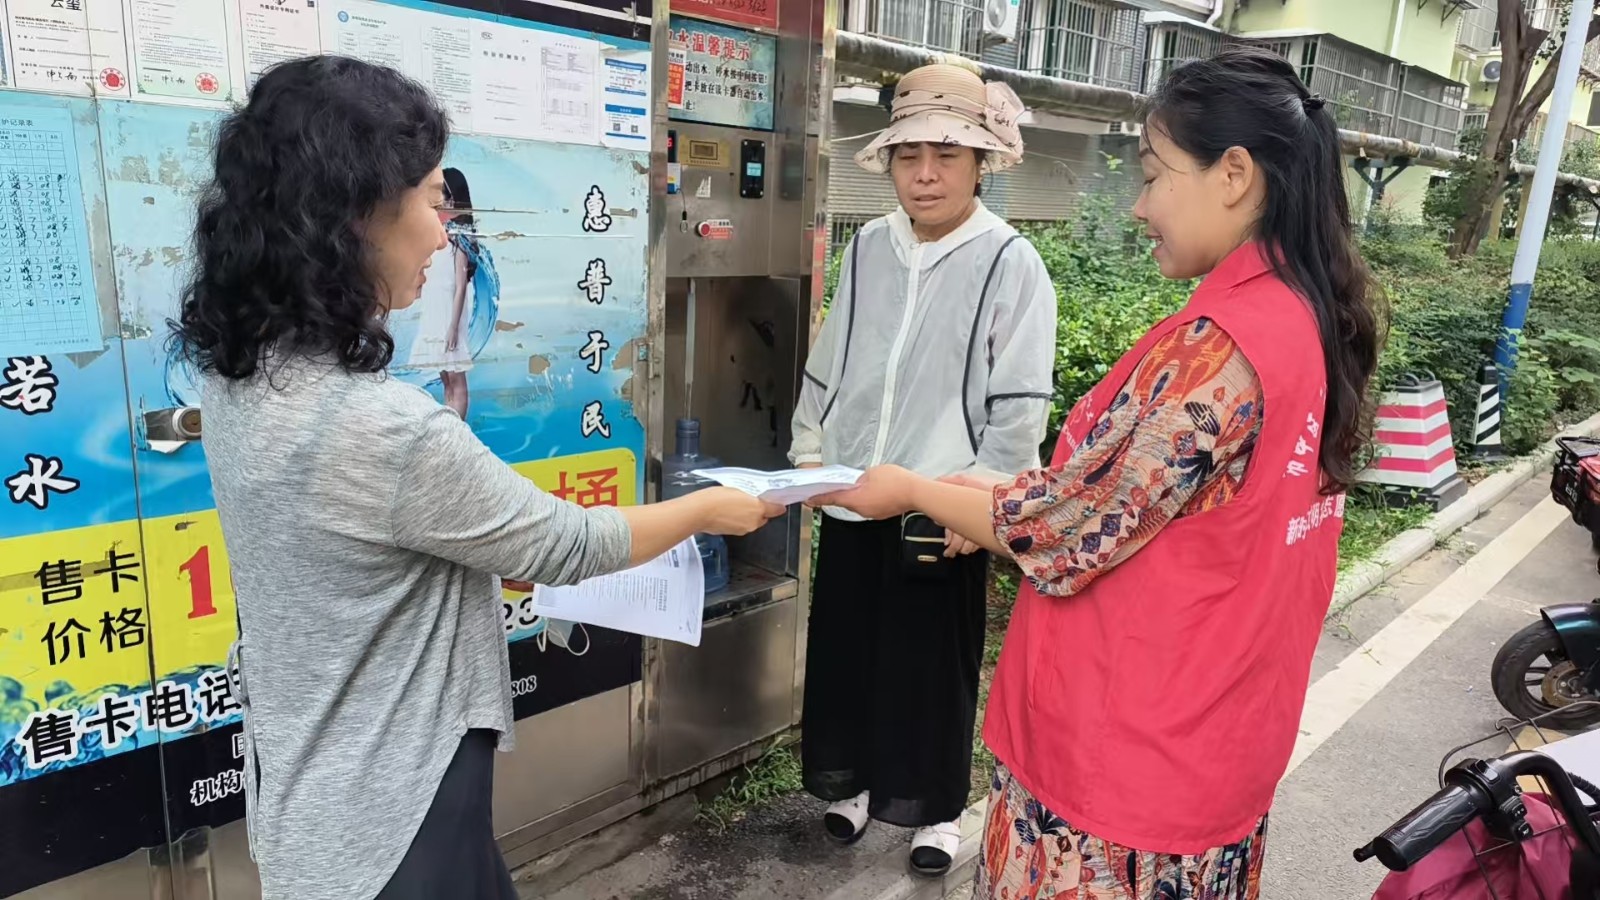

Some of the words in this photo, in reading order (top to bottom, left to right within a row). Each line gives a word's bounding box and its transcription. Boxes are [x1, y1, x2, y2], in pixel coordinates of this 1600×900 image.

[669, 29, 750, 60] 水温馨提示
[578, 184, 613, 439] 惠普于民
[0, 356, 79, 509] 若水
[34, 551, 141, 606] 售卡
[178, 545, 218, 619] 1
[41, 607, 146, 666] 价格
[510, 674, 537, 698] 808
[190, 769, 246, 806] 机构
